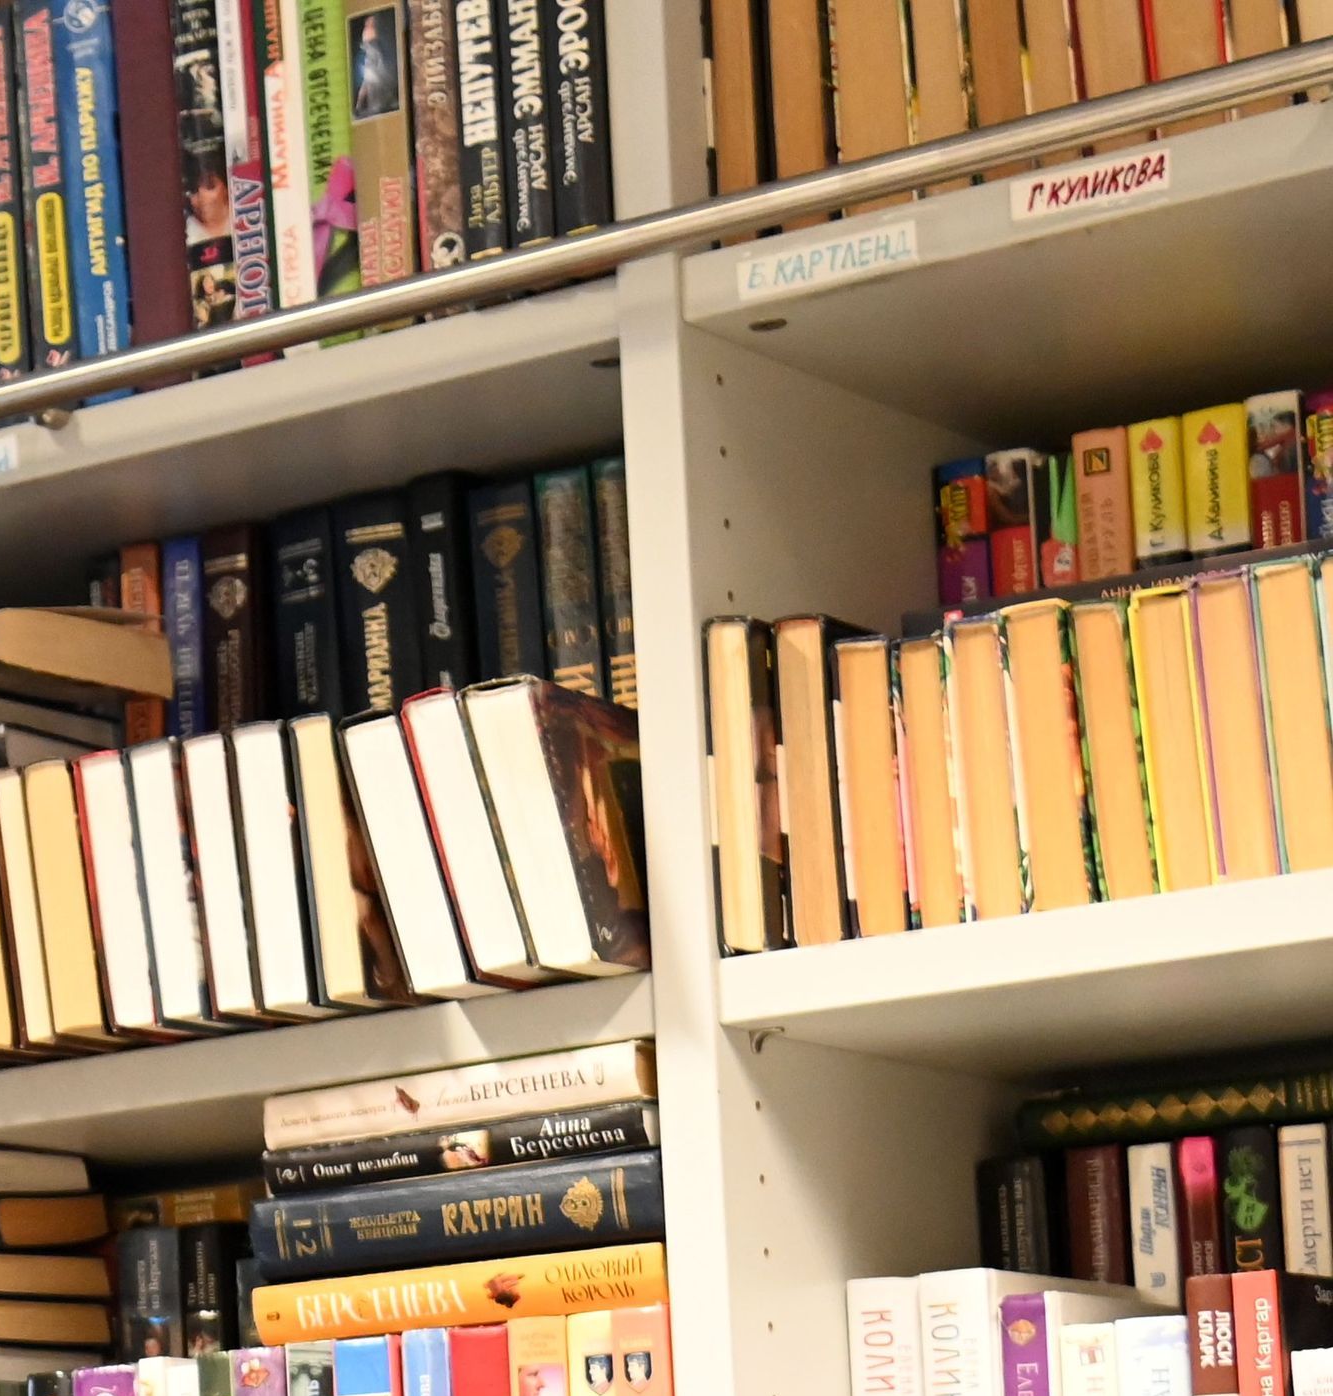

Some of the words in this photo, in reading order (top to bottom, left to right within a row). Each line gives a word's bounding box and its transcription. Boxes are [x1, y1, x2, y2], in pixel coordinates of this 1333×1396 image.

[76, 67, 97, 150] ПАРИЖУ
[560, 81, 576, 185] Эммануэль
[576, 76, 594, 143] АРСАН
[84, 153, 99, 180] ПО
[482, 147, 501, 224] АЛЬТЕР
[514, 129, 531, 231] Эммануэль
[530, 124, 547, 190] АРСАН
[89, 183, 107, 276] АНТИГИД
[470, 1067, 586, 1101] БЕРСЕНЕВА
[510, 1126, 626, 1158] Берсенева
[540, 1117, 591, 1137] Анна
[313, 1161, 353, 1178] Опыт
[357, 1152, 418, 1172] нелюбви
[1294, 1153, 1314, 1192] нет
[441, 1192, 545, 1238] КАТРИН
[297, 1279, 466, 1330] БЕРСЕНЕВА
[1198, 1310, 1216, 1368] КЛАРК
[1215, 1310, 1233, 1366] ЛЮСИ
[1249, 1297, 1272, 1371] Каргар
